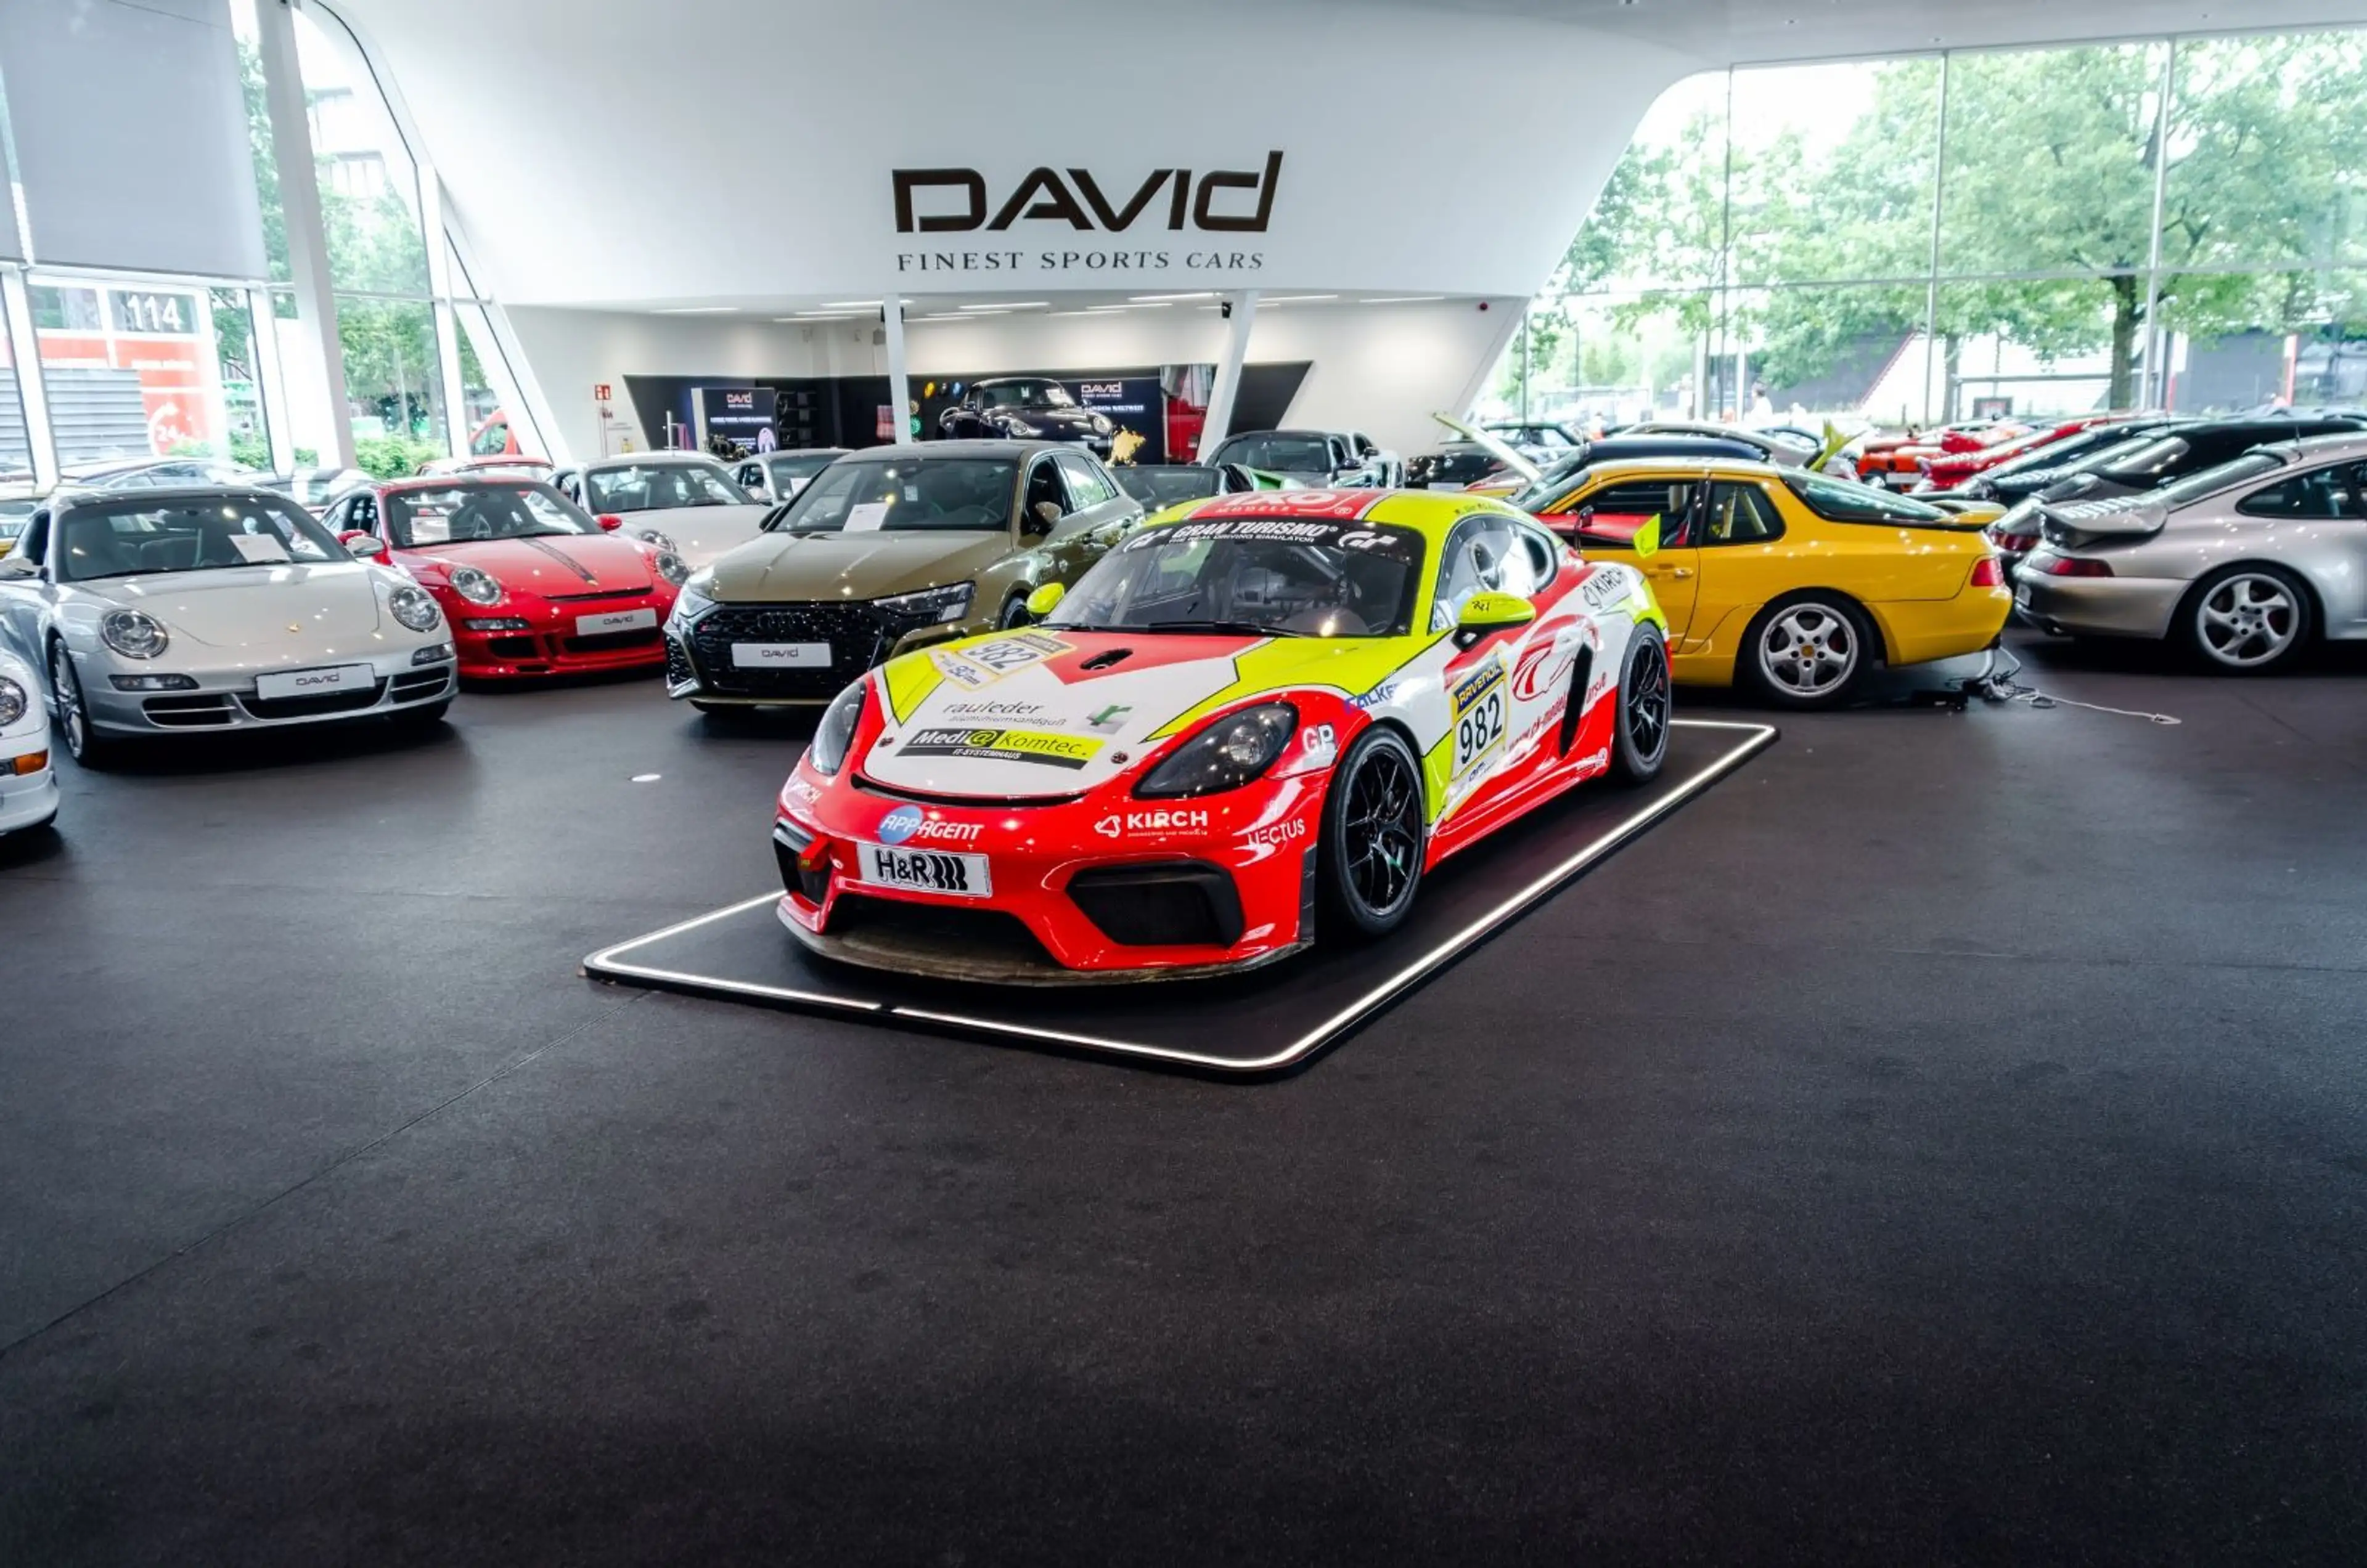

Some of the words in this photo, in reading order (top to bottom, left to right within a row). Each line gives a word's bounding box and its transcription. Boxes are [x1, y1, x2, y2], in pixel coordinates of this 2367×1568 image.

[897, 251, 1023, 271] FINEST
[1040, 251, 1169, 270] SPORTS
[1185, 251, 1264, 270] CARS
[127, 295, 183, 332] 114
[1172, 522, 1233, 539] GRAN
[1255, 534, 1315, 543] SIMULATOR
[943, 701, 1047, 714] rauleder
[1459, 692, 1503, 764] 982
[1302, 724, 1334, 754] GP
[952, 748, 1021, 759] IT-SYSTEMHAUS
[1127, 811, 1208, 829] KIRCH
